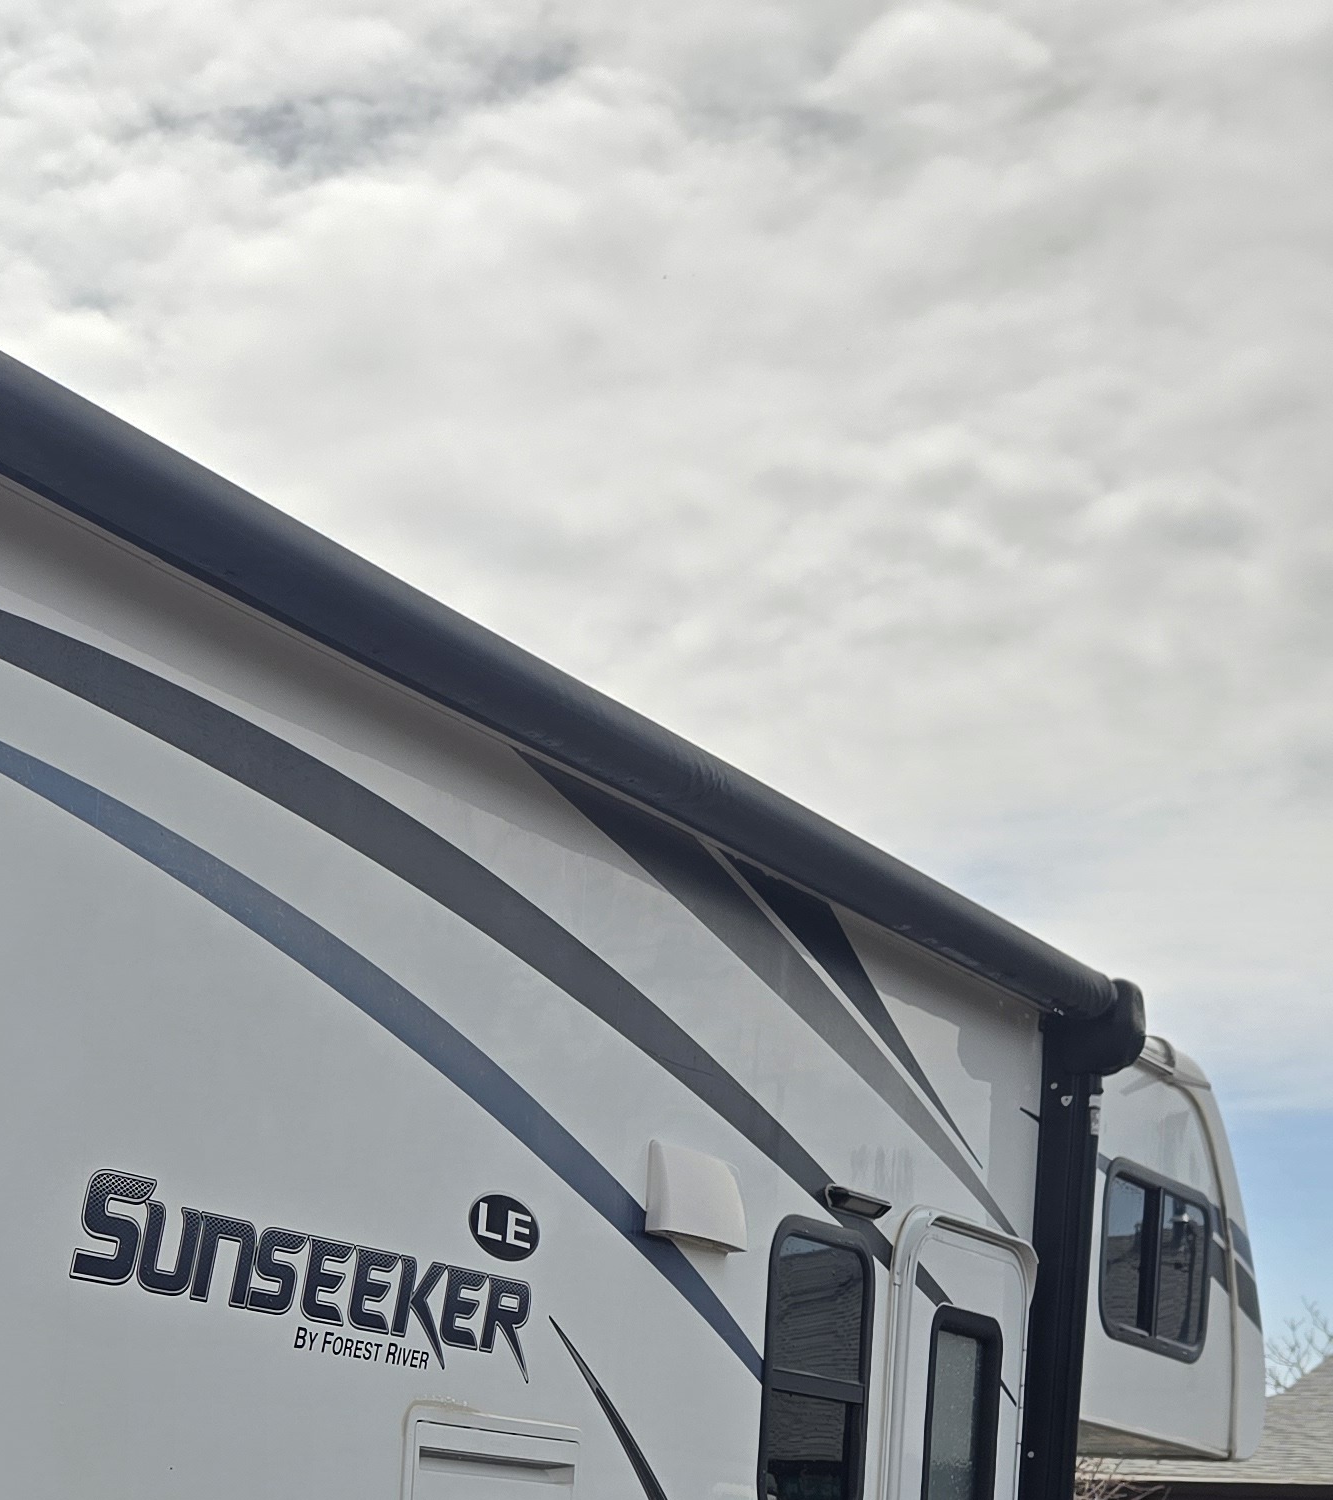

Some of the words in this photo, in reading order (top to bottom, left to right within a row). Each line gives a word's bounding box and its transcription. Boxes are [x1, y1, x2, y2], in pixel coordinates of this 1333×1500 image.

[476, 1200, 532, 1250] LE
[321, 1330, 383, 1363] FOREST
[386, 1341, 430, 1371] RIVER
